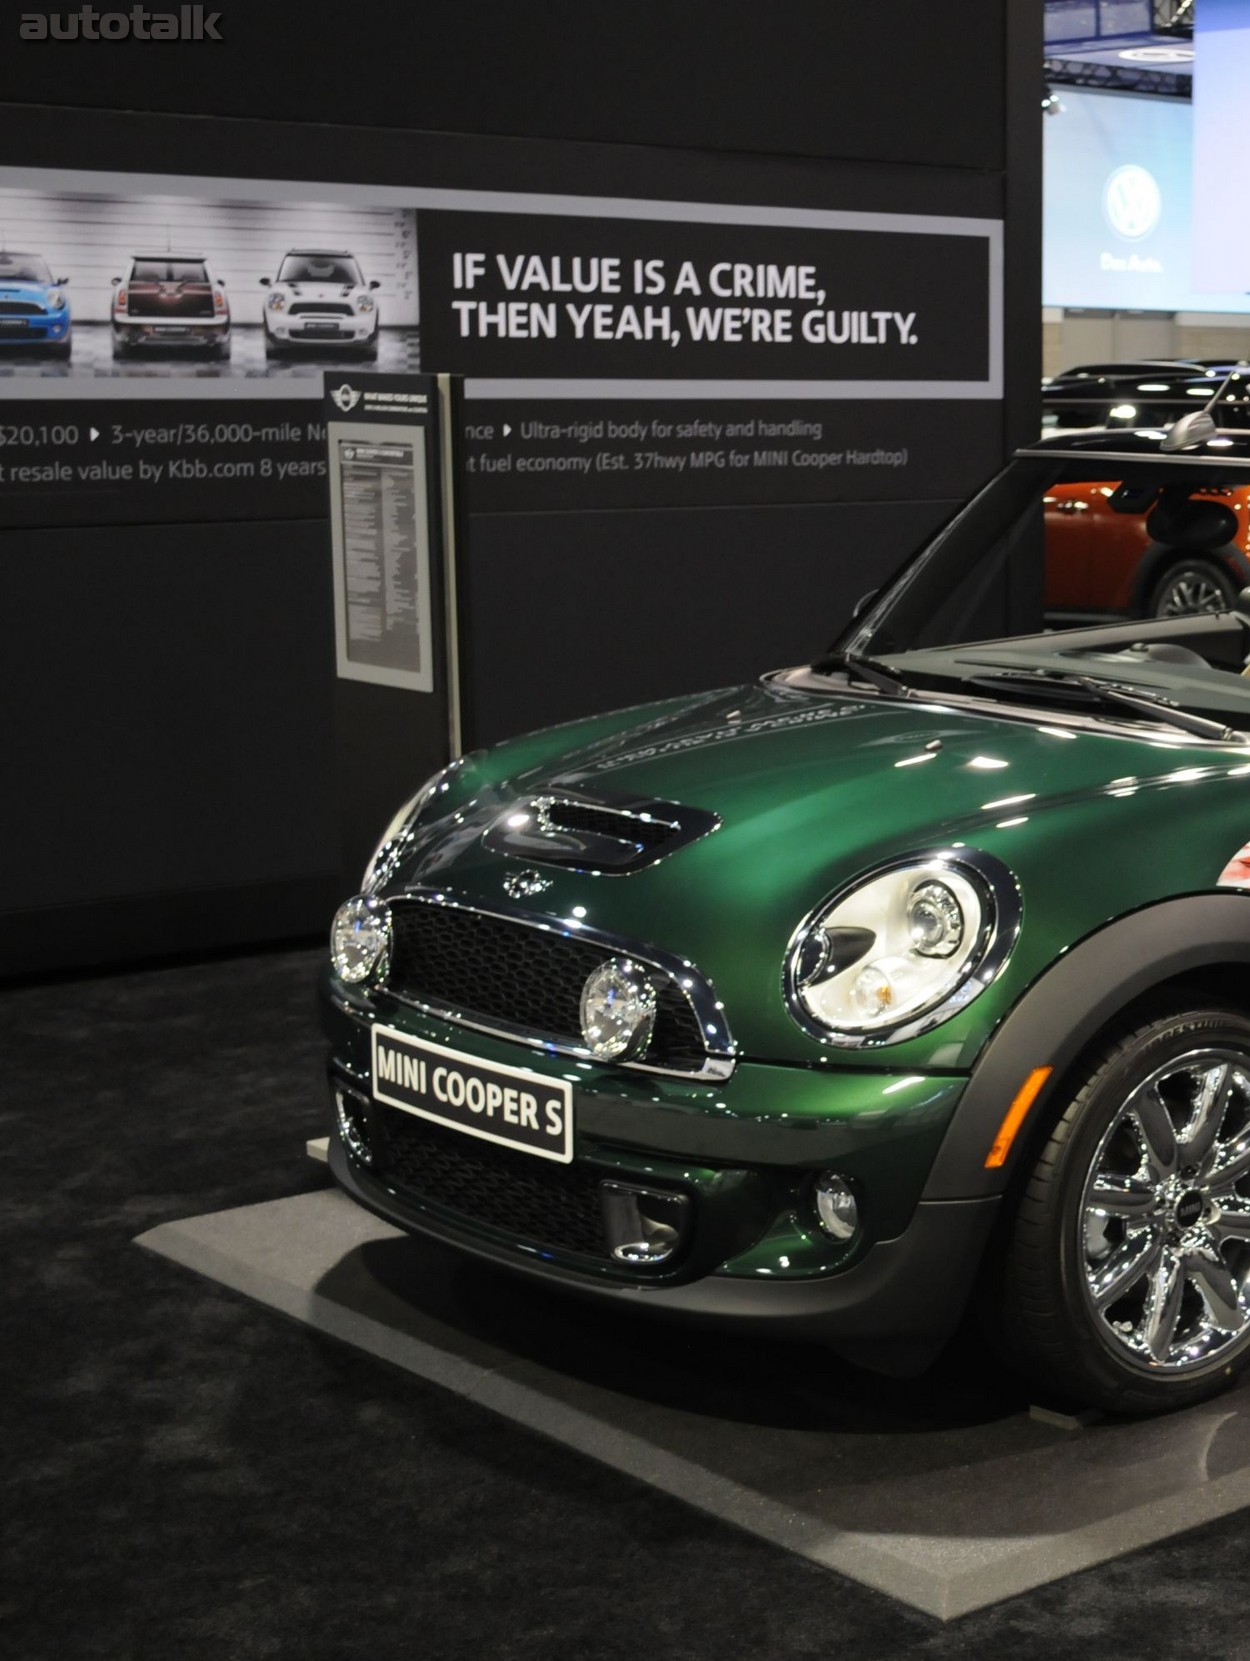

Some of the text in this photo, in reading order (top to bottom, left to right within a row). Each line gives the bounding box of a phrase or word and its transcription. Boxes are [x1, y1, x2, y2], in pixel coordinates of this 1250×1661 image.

[452, 252, 486, 290] IF
[496, 254, 621, 294] VALUE
[633, 258, 666, 295] IS
[673, 261, 701, 296] A
[709, 262, 827, 305] CRIME,
[451, 300, 919, 347] THEN YEAH, WE'RE GUILTY.
[111, 423, 302, 447] 3-year/36,000-mile
[520, 421, 604, 443] Ultra-rigid
[607, 422, 648, 441] body
[651, 420, 673, 438] for
[676, 419, 723, 440] safety
[725, 420, 755, 437] and
[758, 419, 823, 440] handling
[10, 461, 73, 482] resale
[77, 460, 134, 480] value
[139, 460, 163, 483] by
[168, 458, 255, 479] Kbb.com
[260, 458, 273, 477] 8
[276, 459, 328, 478] years
[479, 453, 512, 472] fuel
[516, 455, 592, 474] economy
[595, 452, 629, 472] (Est.
[634, 452, 687, 472] 37hwy
[689, 451, 726, 468] MPG
[729, 449, 751, 467] for
[753, 449, 789, 467] MINI
[792, 449, 843, 468] Cooper
[846, 448, 909, 467] Hardtop)
[378, 1045, 563, 1136] MINI COOPER S
